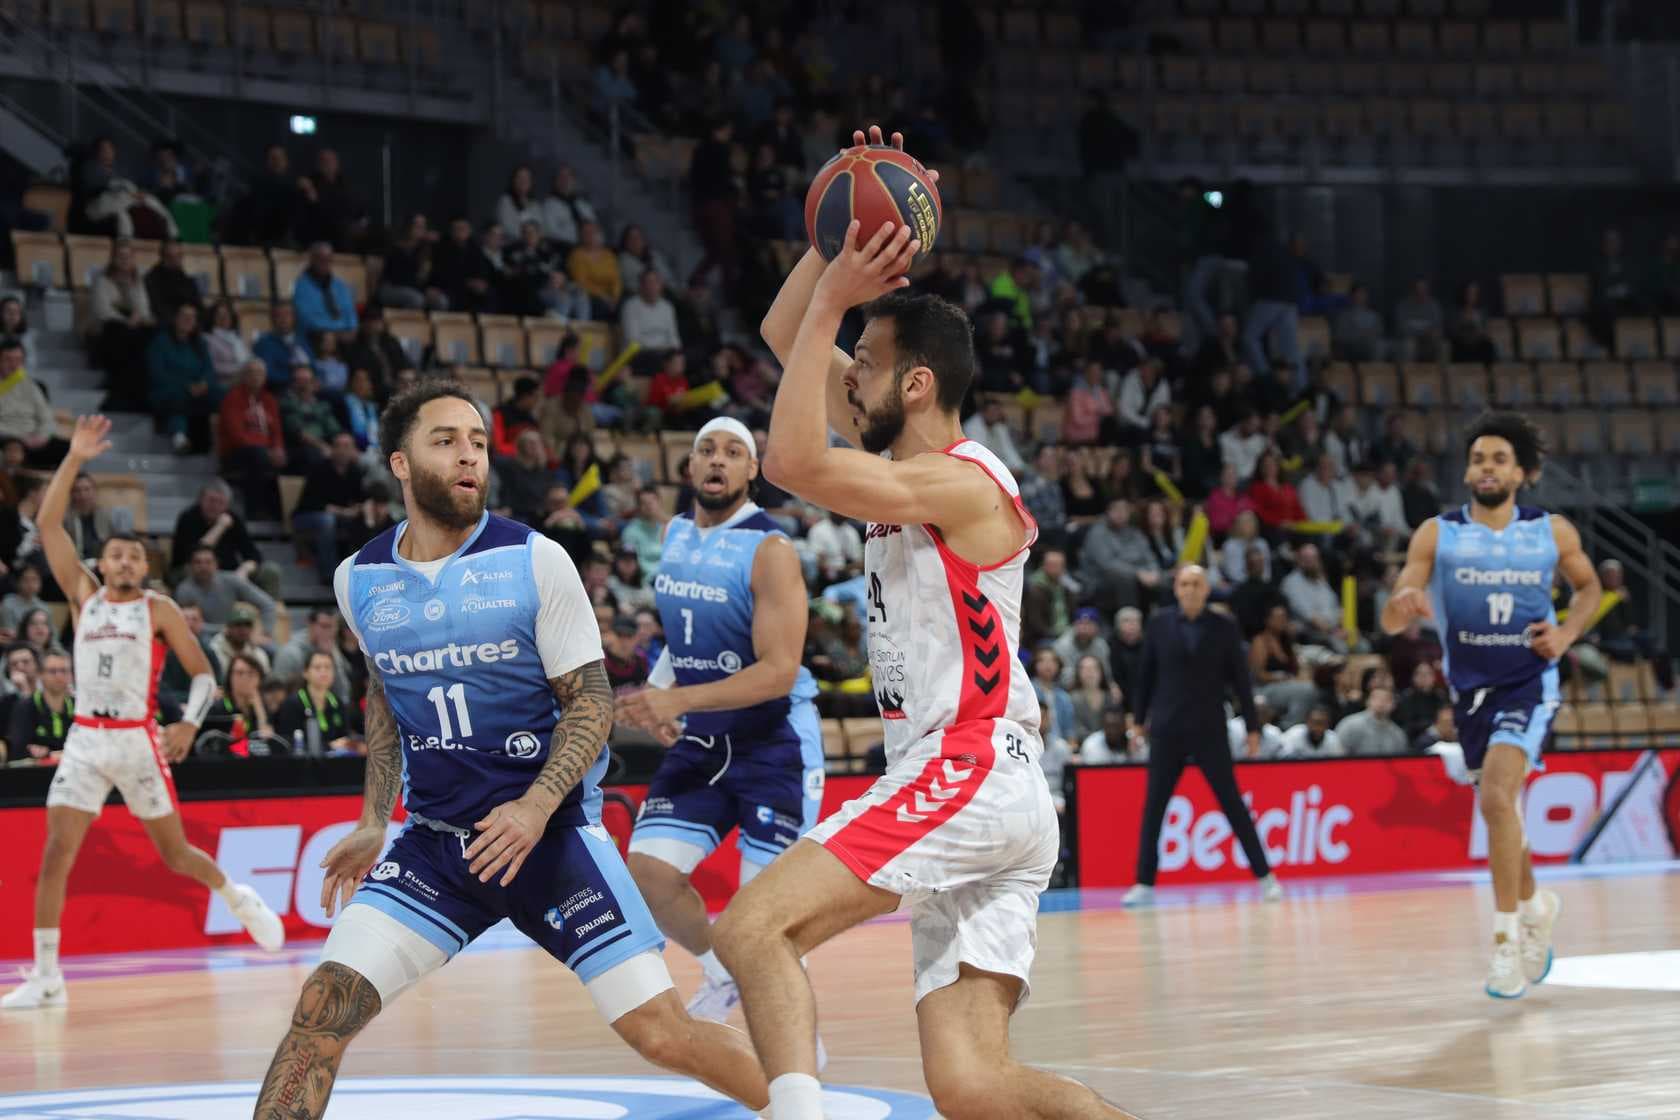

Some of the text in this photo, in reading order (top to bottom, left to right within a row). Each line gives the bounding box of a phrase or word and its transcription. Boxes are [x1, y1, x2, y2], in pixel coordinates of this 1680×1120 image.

[655, 574, 729, 603] Chartres
[1455, 566, 1541, 586] Chartres
[372, 607, 401, 623] Ford
[1486, 592, 1515, 625] 19
[681, 609, 693, 645] 1
[374, 639, 519, 675] Chartres
[426, 683, 473, 741] 11
[1006, 733, 1030, 764] 24
[558, 887, 593, 913] CHARTRES
[575, 910, 615, 938] SPALDING
